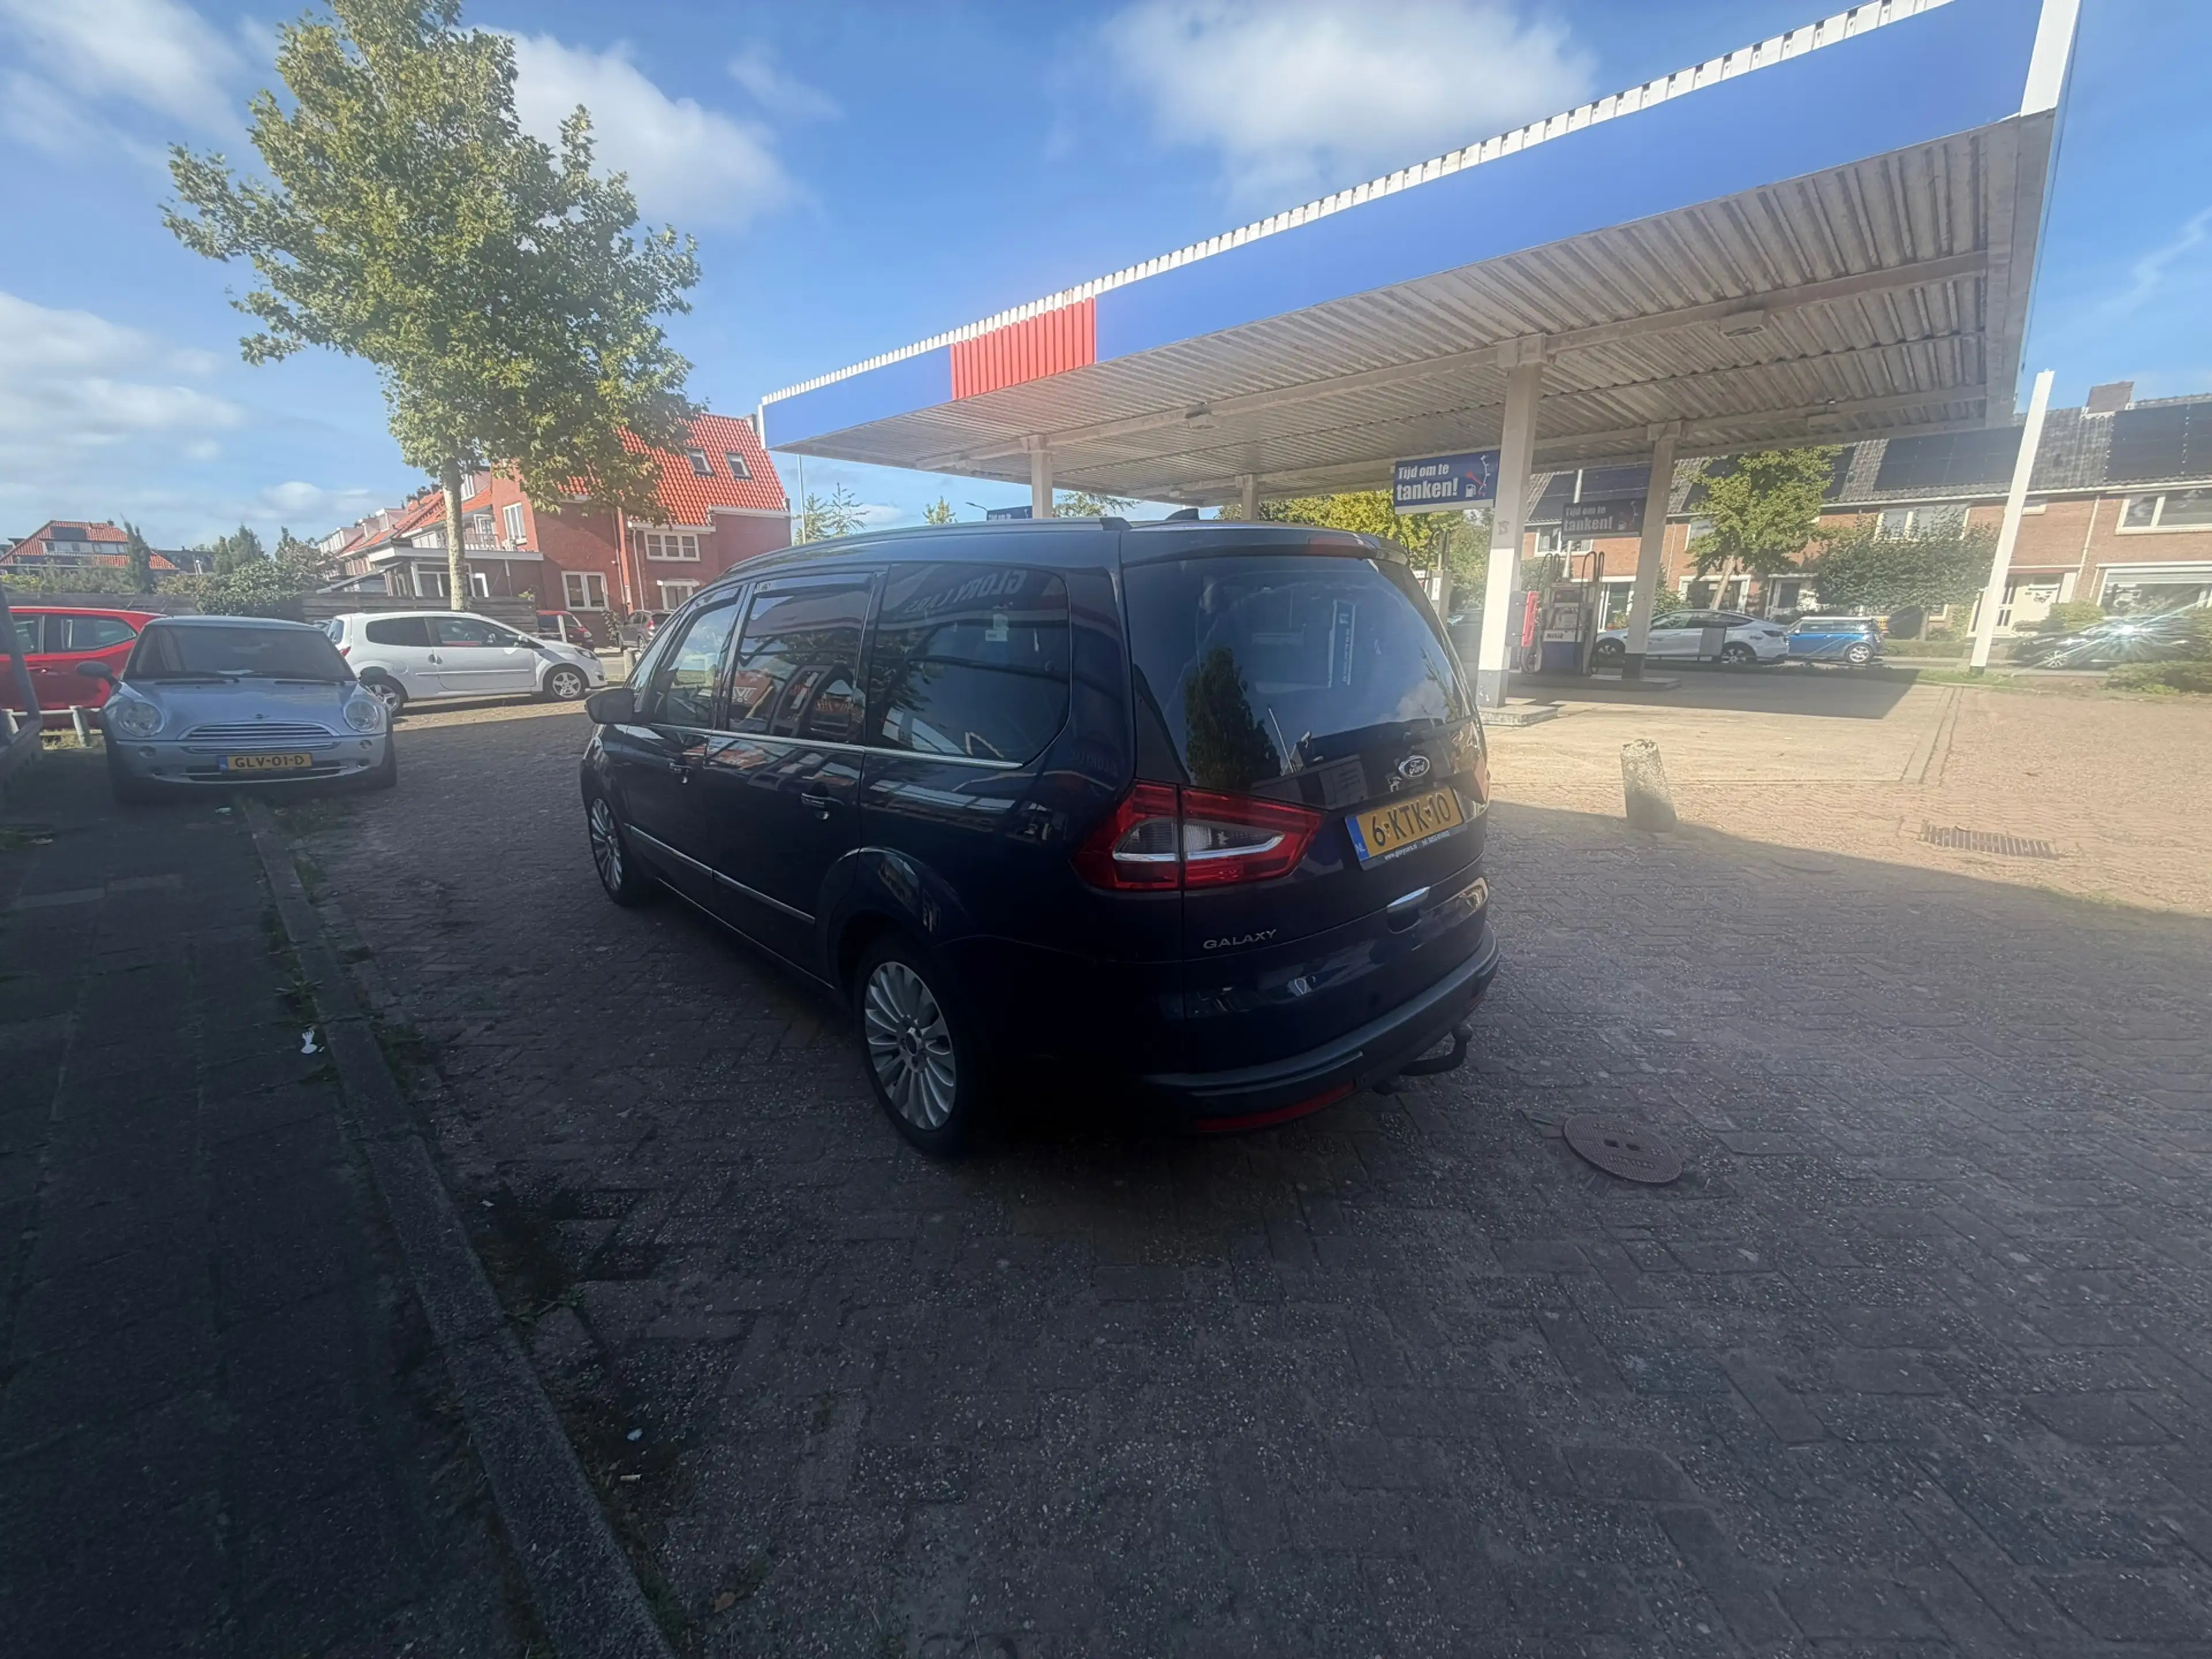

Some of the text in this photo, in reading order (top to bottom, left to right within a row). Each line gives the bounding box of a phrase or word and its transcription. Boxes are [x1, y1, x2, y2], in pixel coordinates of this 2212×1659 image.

[1398, 463, 1450, 480] Tijd om te
[1396, 477, 1459, 501] tanken!
[1582, 507, 1596, 516] om
[1563, 516, 1613, 531] tanken!
[234, 755, 305, 768] GLV-01-D
[1371, 791, 1451, 846] 6-KTK-10
[1354, 843, 1366, 853] NL
[1203, 928, 1277, 949] GALAXY
